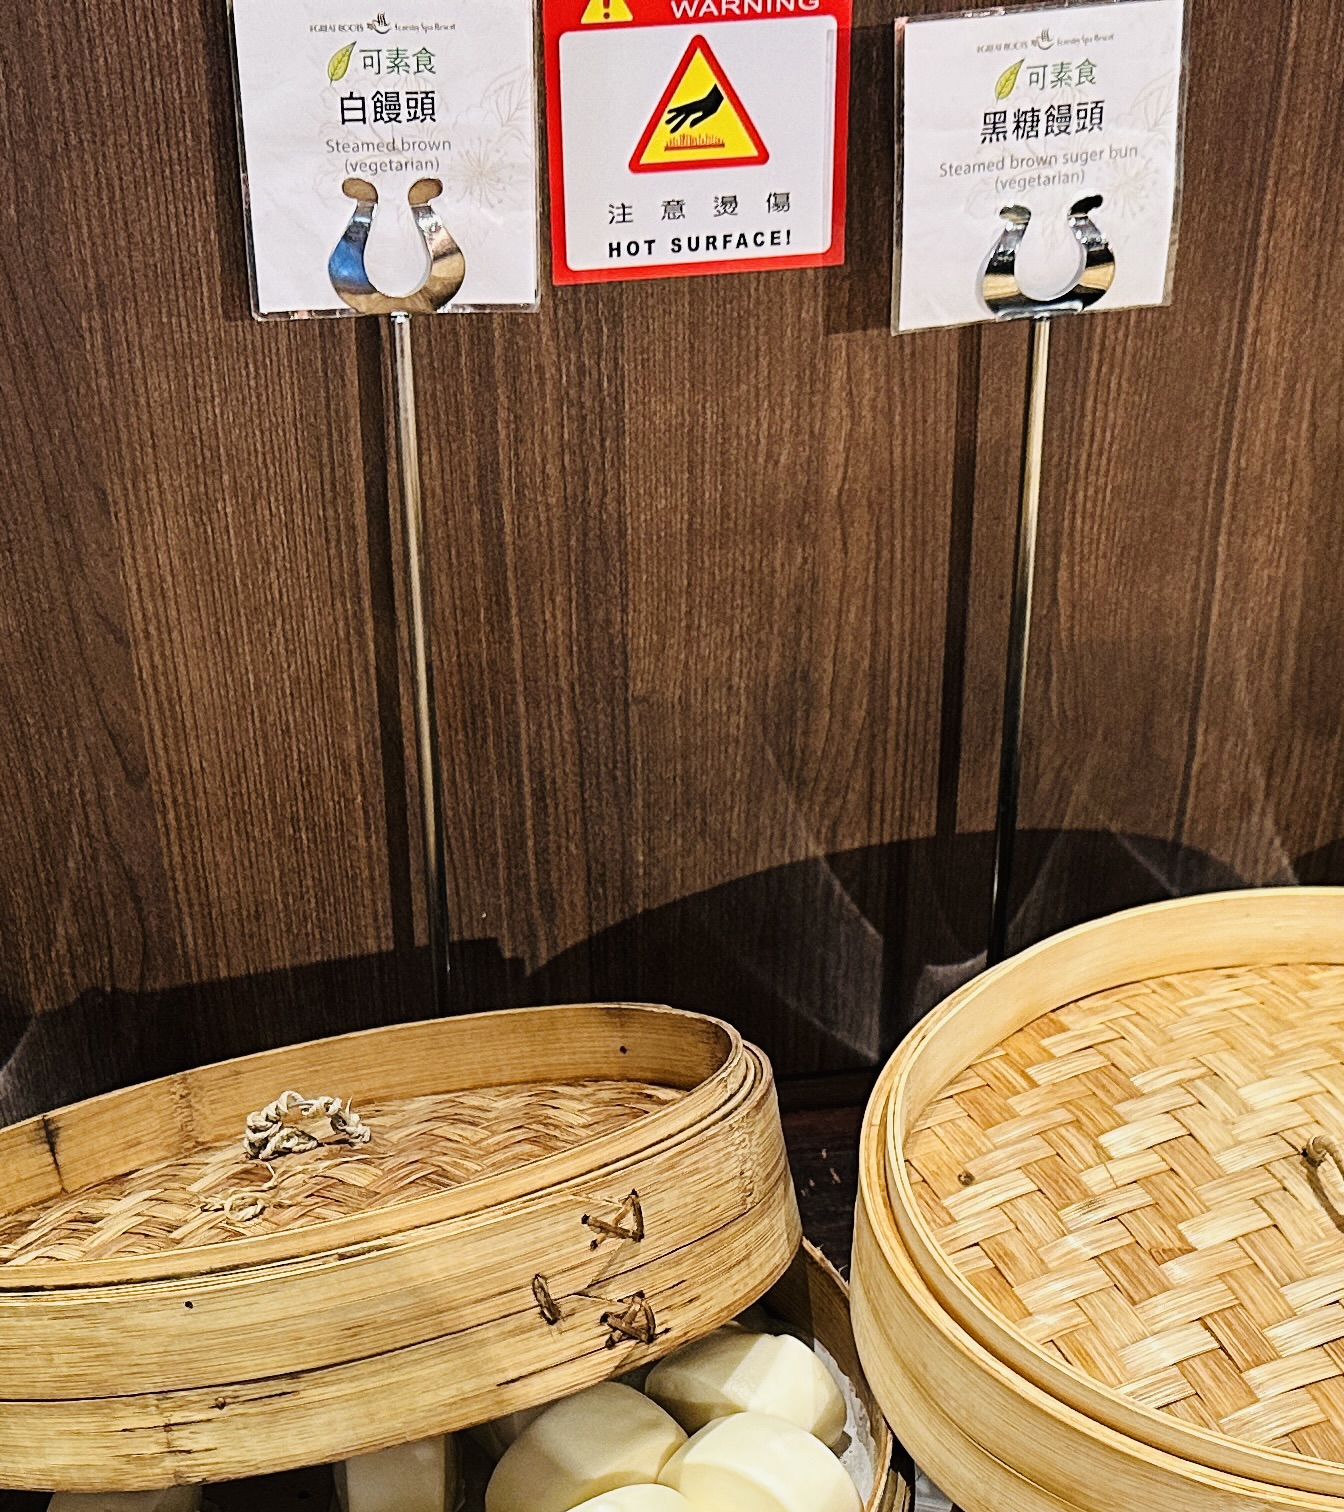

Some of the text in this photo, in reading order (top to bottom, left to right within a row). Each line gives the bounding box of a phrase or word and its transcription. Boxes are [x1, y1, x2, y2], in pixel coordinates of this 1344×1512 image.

[671, 0, 819, 19] WARNING
[358, 46, 437, 76] 可素食
[1026, 57, 1097, 91] 可素食
[339, 90, 437, 125] 白饅頭
[980, 99, 1106, 145] 黑糖饅頭
[325, 136, 452, 154] Steamed brown
[345, 156, 440, 176] (vegetarian)
[939, 144, 1138, 177] Steamed brown suger bun
[994, 169, 1086, 193] (vegetarian)
[608, 191, 791, 225] 注意燙傷
[608, 229, 792, 258] HOT SURFACE!
